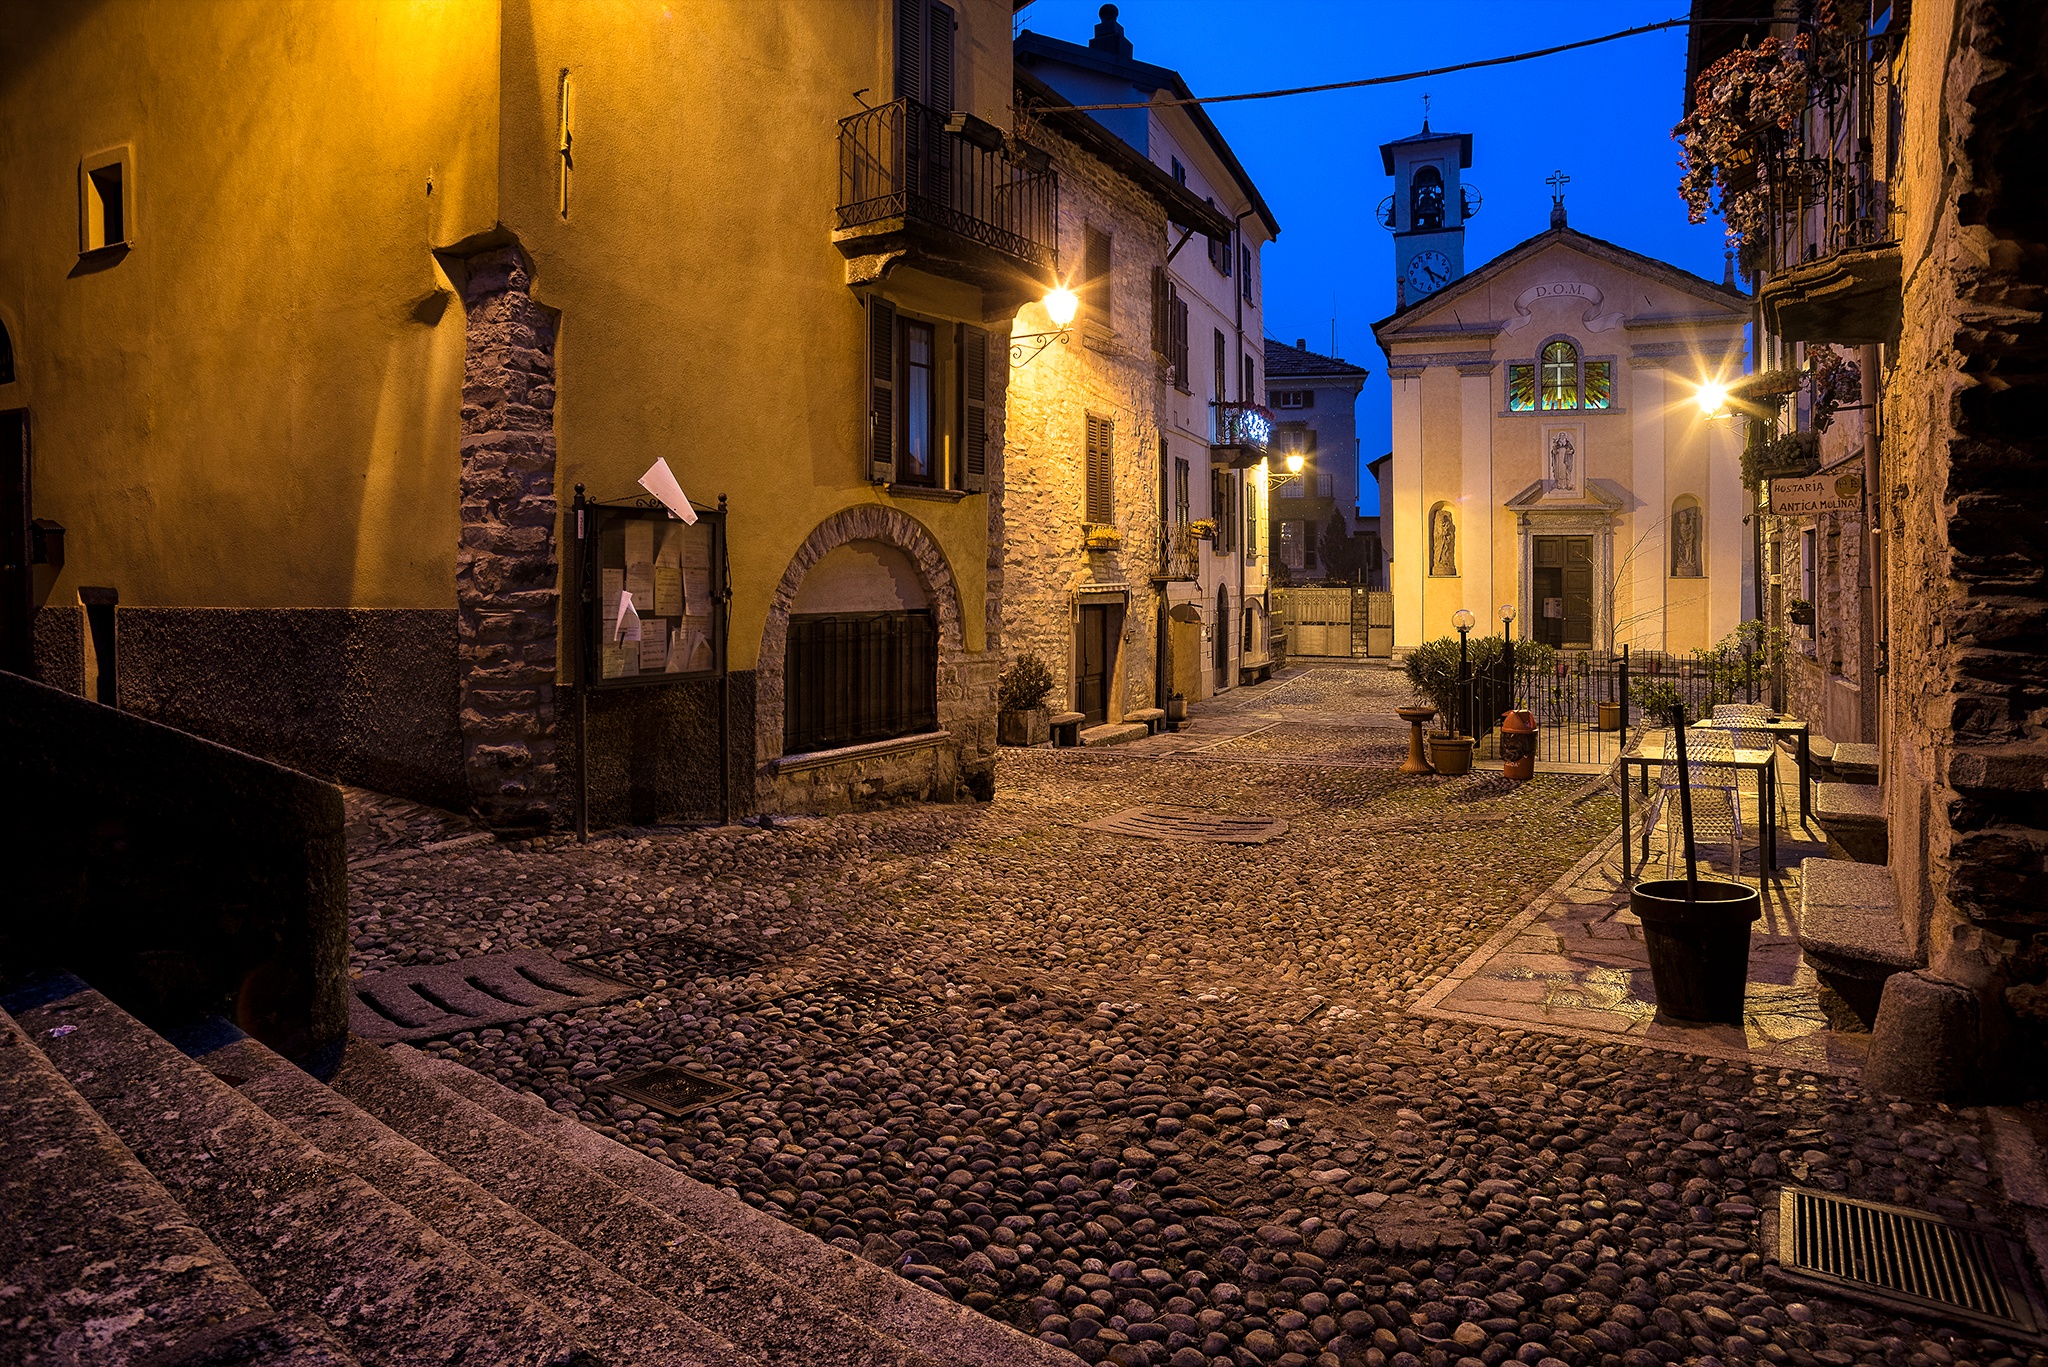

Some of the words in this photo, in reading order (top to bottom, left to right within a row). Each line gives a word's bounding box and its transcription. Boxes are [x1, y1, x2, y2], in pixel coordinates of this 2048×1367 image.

[1418, 255, 1423, 263] 11
[1425, 252, 1432, 260] 12
[1412, 261, 1419, 269] 10
[1536, 283, 1585, 297] D.O.M.
[1774, 480, 1825, 493] HOSTARIA
[1779, 499, 1818, 512] ANTICA
